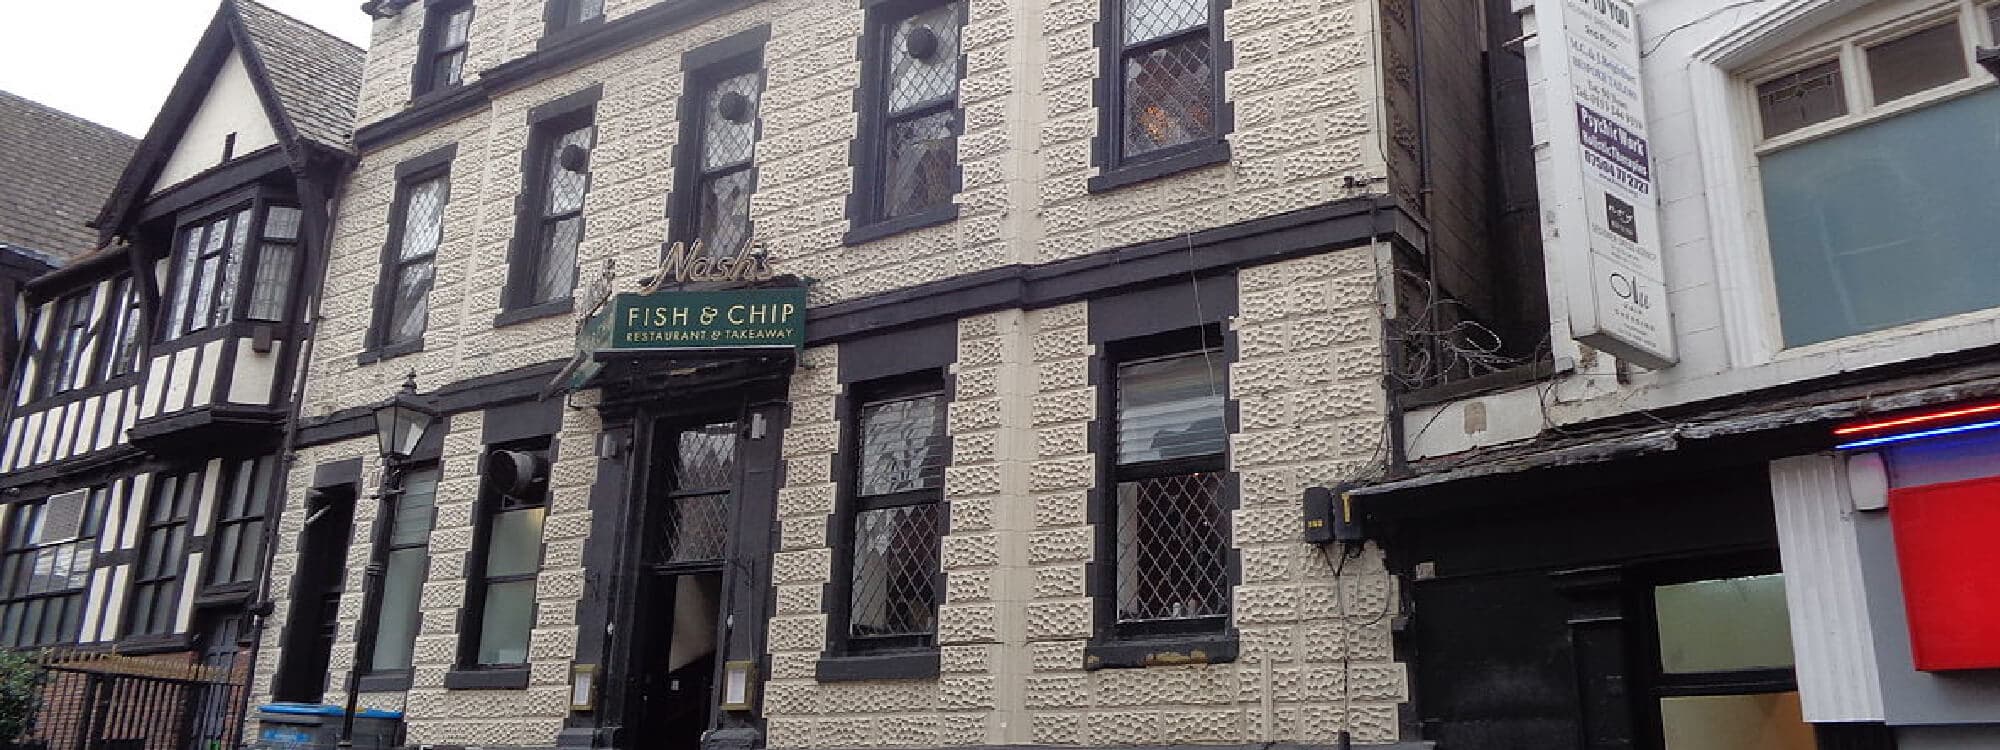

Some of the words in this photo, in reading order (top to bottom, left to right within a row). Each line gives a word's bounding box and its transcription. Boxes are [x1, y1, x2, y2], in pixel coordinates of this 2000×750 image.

[1608, 1, 1630, 29] YOU
[628, 307, 689, 327] FISH
[700, 305, 718, 326] &
[727, 303, 794, 325] CHIP
[626, 329, 706, 343] RESTAURANT
[711, 330, 721, 341] &
[725, 328, 794, 341] TAKEAWAY
